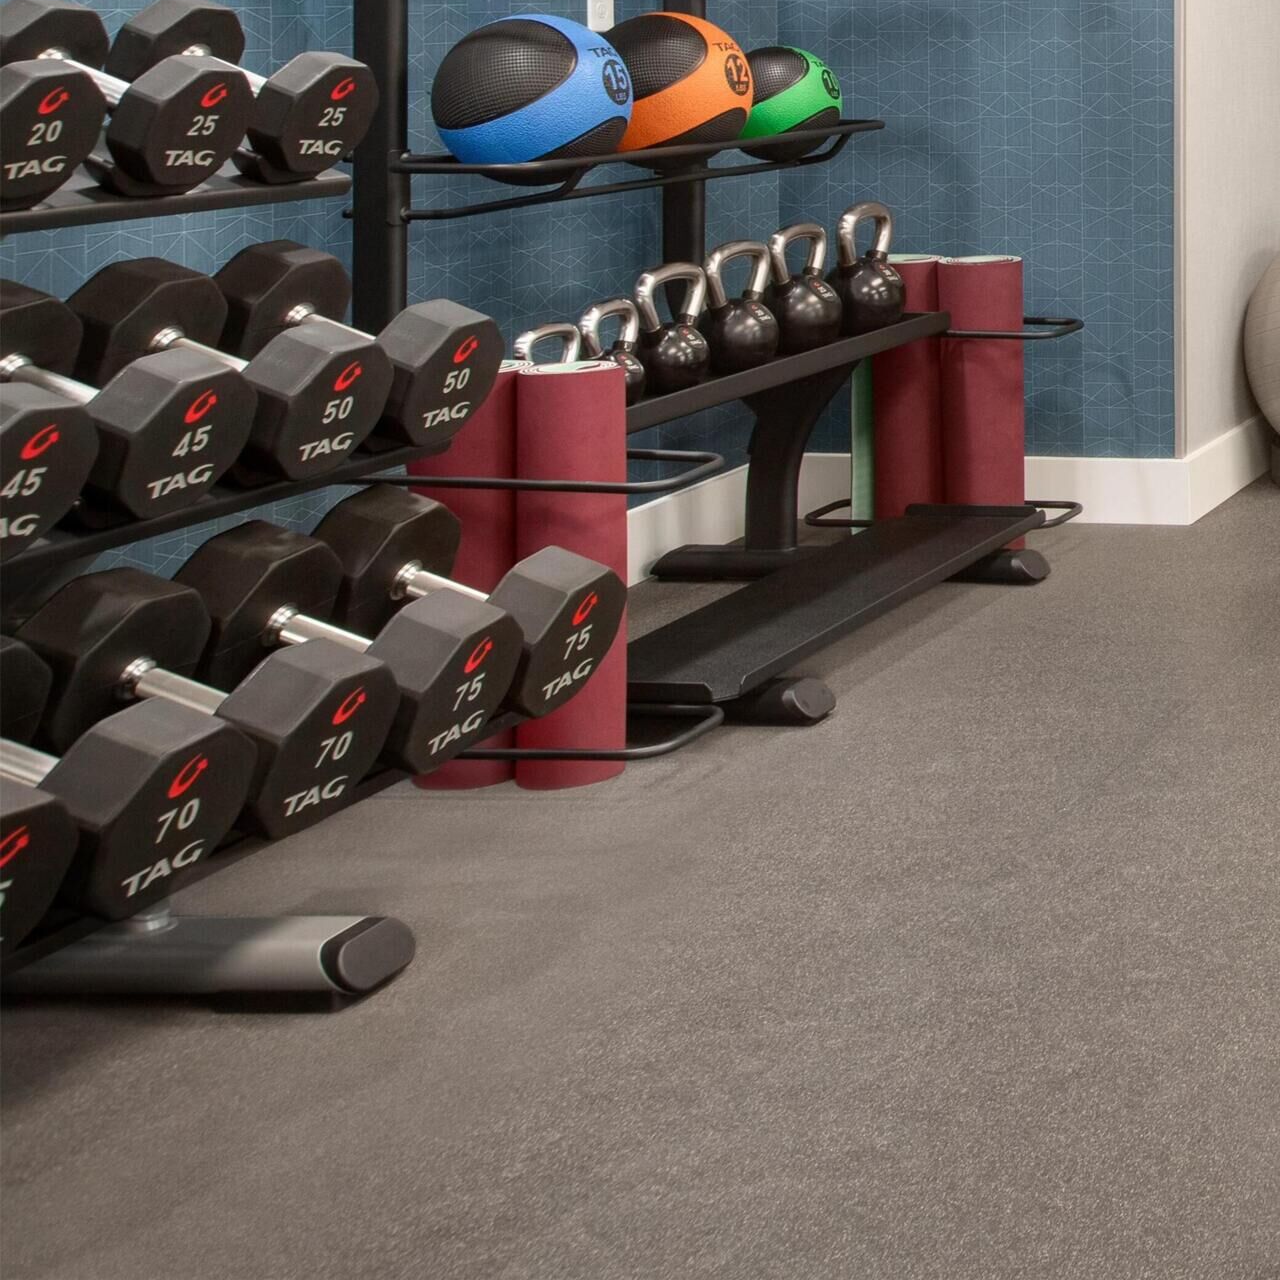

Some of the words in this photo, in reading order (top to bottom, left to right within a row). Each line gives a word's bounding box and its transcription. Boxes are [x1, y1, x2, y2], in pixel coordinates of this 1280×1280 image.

[605, 64, 626, 89] 15
[727, 59, 748, 82] 12
[187, 115, 219, 136] 25
[318, 107, 347, 127] 25
[27, 120, 63, 146] 20
[298, 139, 343, 156] TAG
[4, 156, 68, 180] TAG
[165, 150, 216, 167] TAG
[443, 368, 471, 394] 50
[323, 396, 354, 424] 50
[422, 401, 471, 429] TAG
[171, 425, 212, 457] 45
[299, 431, 354, 462] TAG
[0, 467, 48, 499] 45
[147, 463, 214, 499] TAG
[563, 624, 593, 661] 75
[452, 672, 486, 712] 75
[542, 658, 593, 701] TAG
[427, 709, 484, 755] TAG
[314, 731, 353, 769] 70
[284, 776, 348, 817] TAG
[156, 798, 200, 844] 70
[122, 839, 203, 898] TAG
